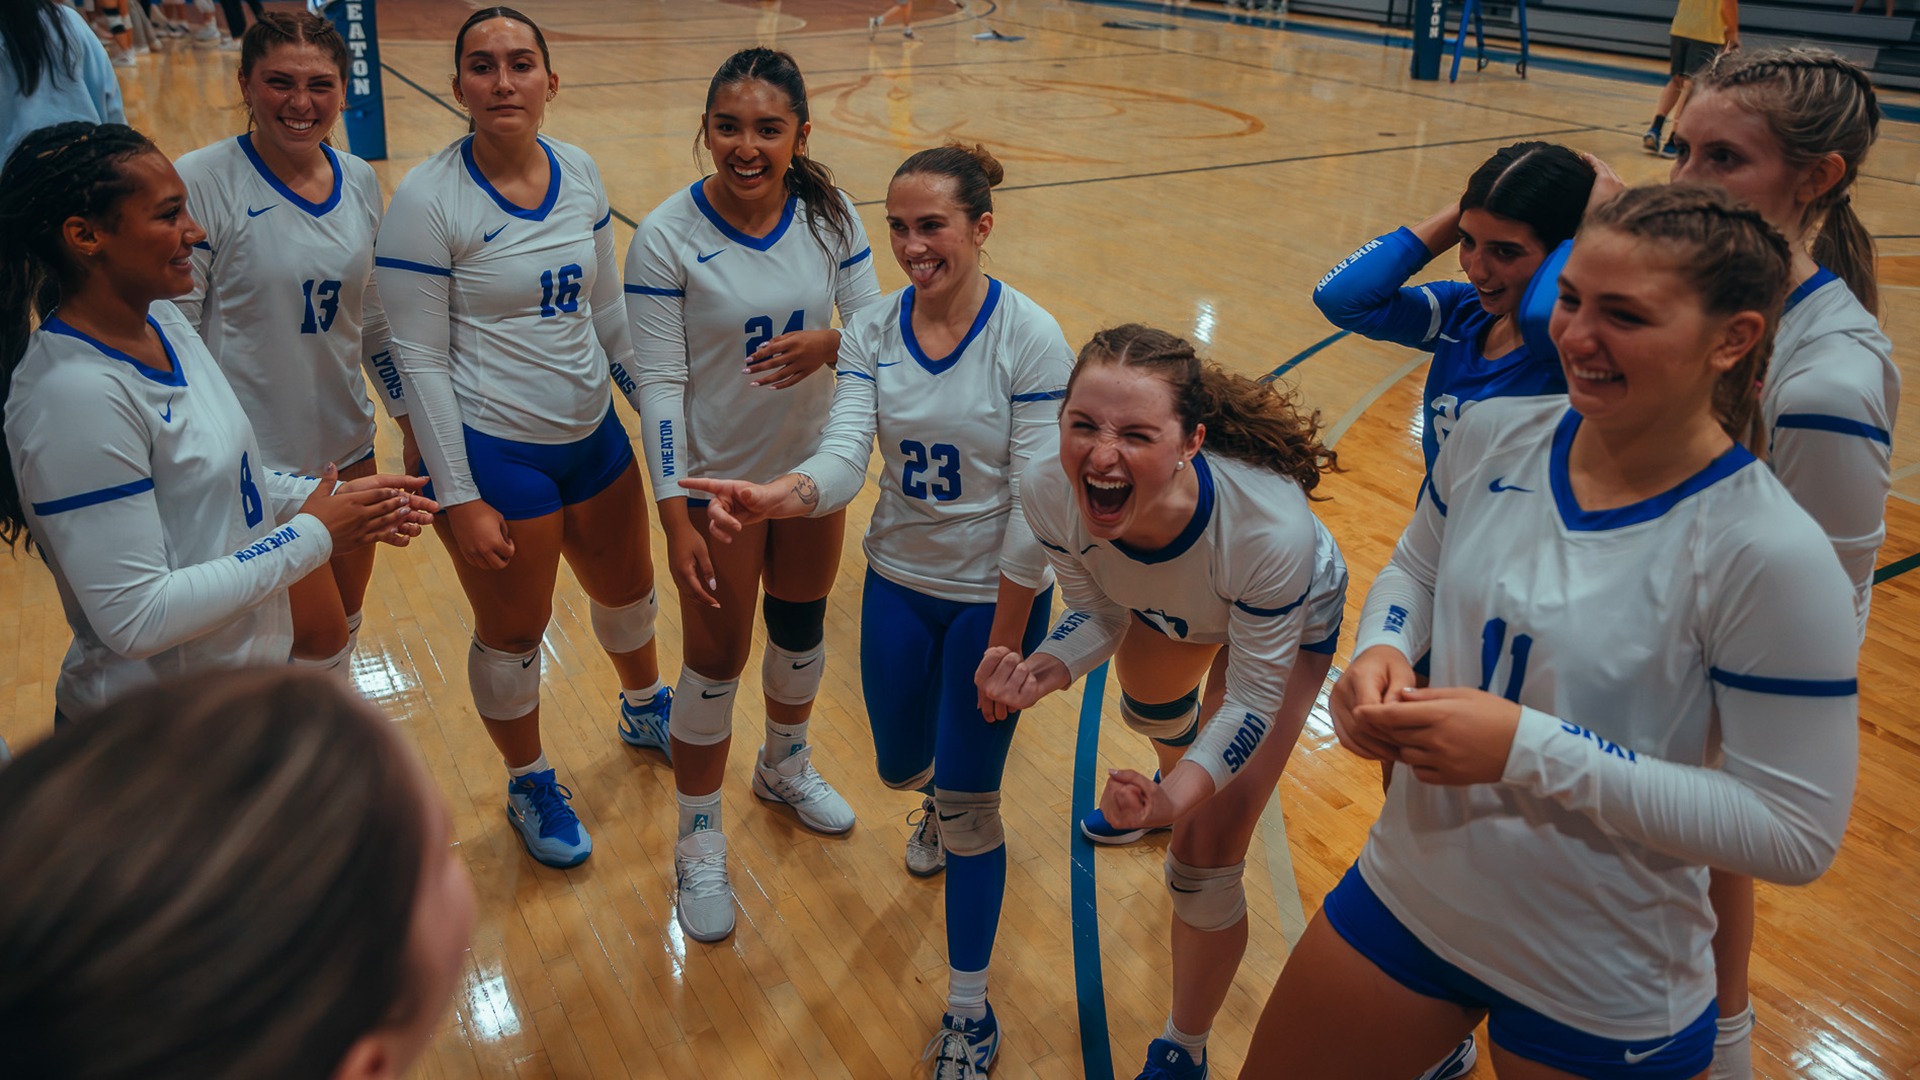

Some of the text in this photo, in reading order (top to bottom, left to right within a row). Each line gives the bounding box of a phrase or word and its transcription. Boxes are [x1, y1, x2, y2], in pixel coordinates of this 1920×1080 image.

[1429, 0, 1442, 38] TON
[344, 0, 370, 95] EATON
[540, 263, 582, 317] 16
[1317, 239, 1384, 292] WHEATON
[301, 279, 342, 333] 13
[371, 350, 404, 400] LYONS
[610, 362, 636, 394] ONS
[660, 420, 675, 478] WHEATON
[899, 439, 962, 501] 23
[240, 450, 263, 529] 8
[1478, 617, 1533, 704] 11
[1223, 712, 1266, 774] LYONS
